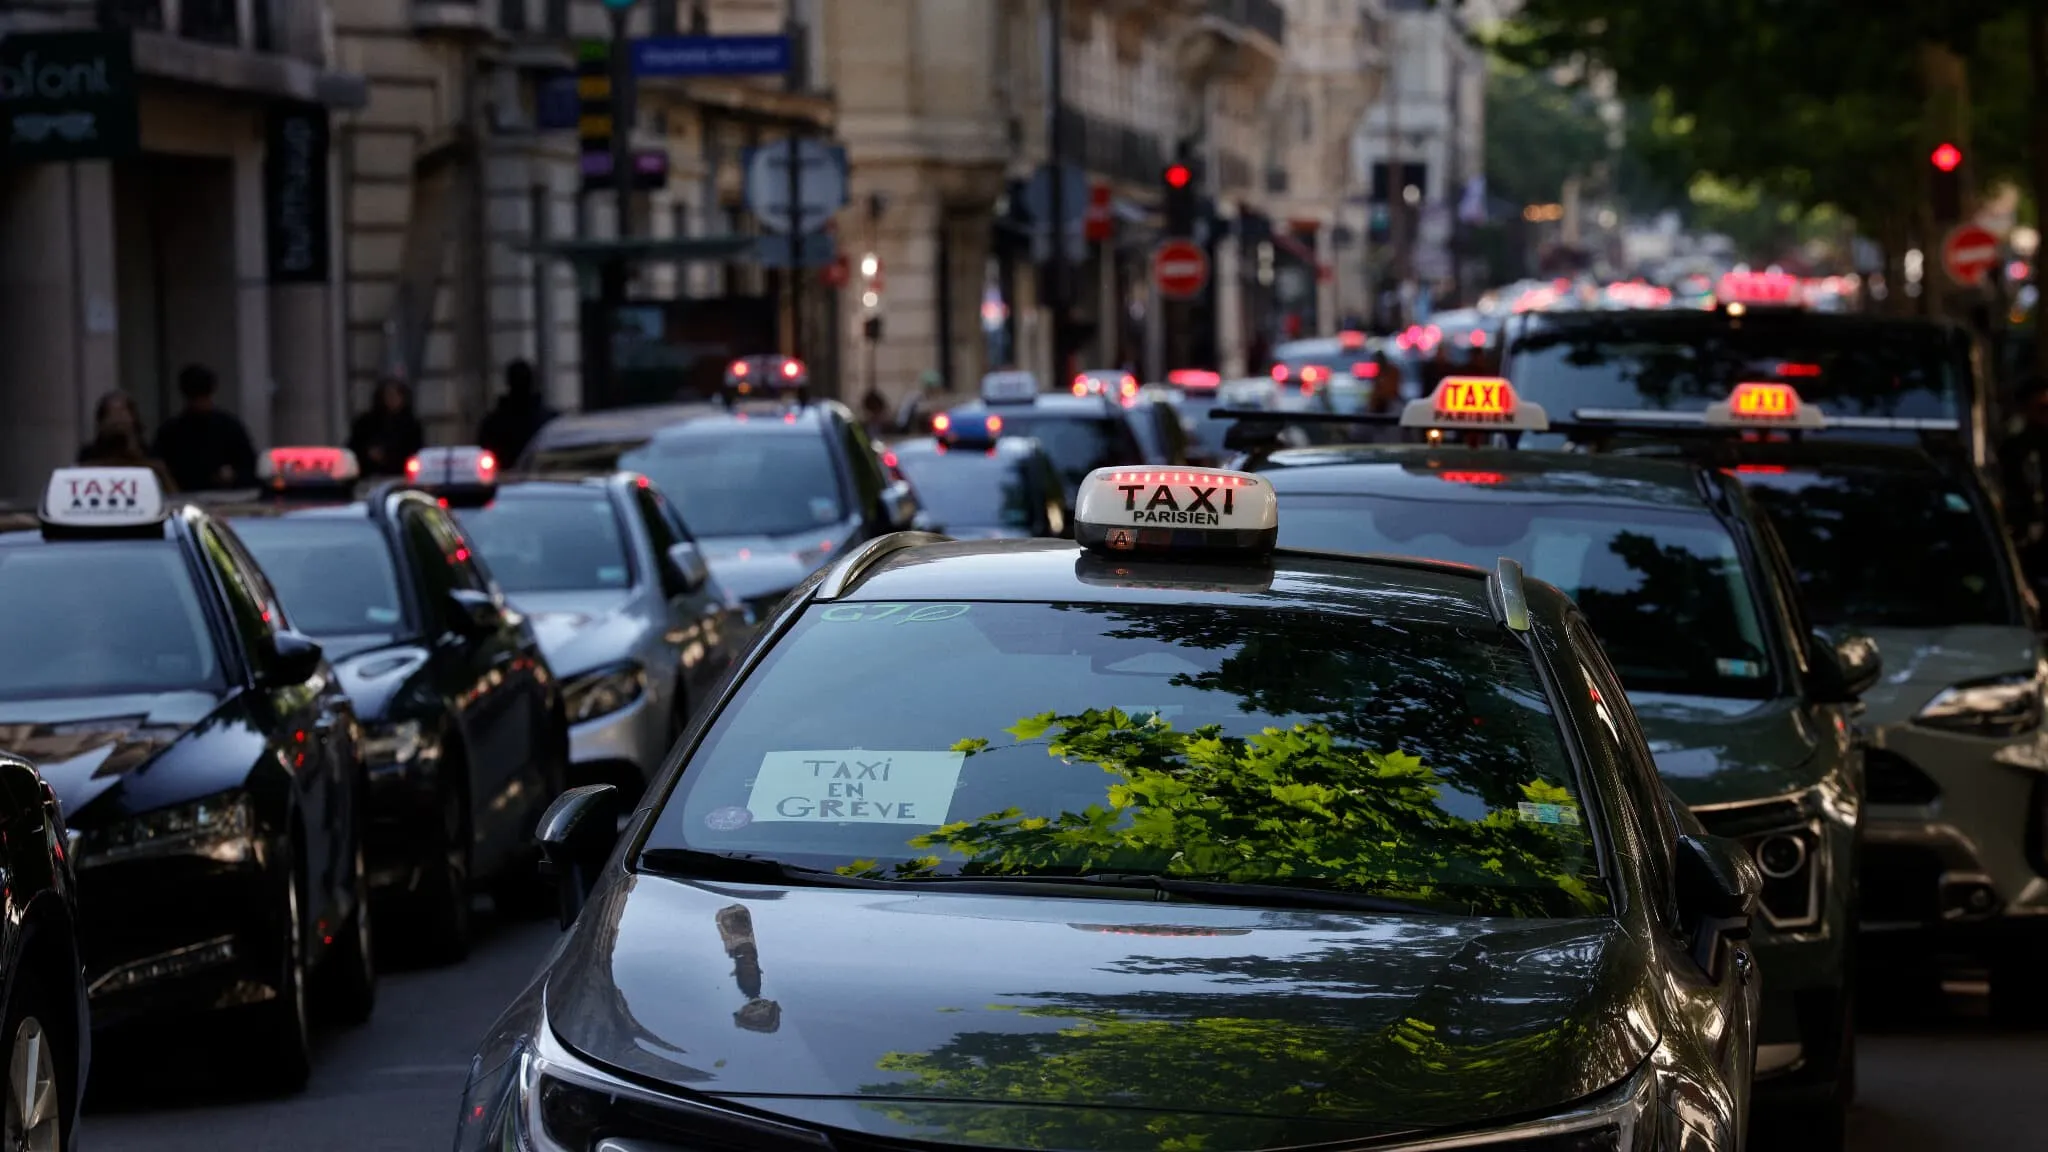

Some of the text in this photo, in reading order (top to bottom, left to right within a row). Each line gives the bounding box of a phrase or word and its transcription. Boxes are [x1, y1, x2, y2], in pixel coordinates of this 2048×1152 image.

[1448, 384, 1505, 408] TAXI
[66, 478, 137, 496] TAXI
[1118, 484, 1234, 515] TAXI
[1133, 511, 1219, 525] PARISIEN
[1114, 531, 1128, 546] A
[828, 782, 864, 798] EN
